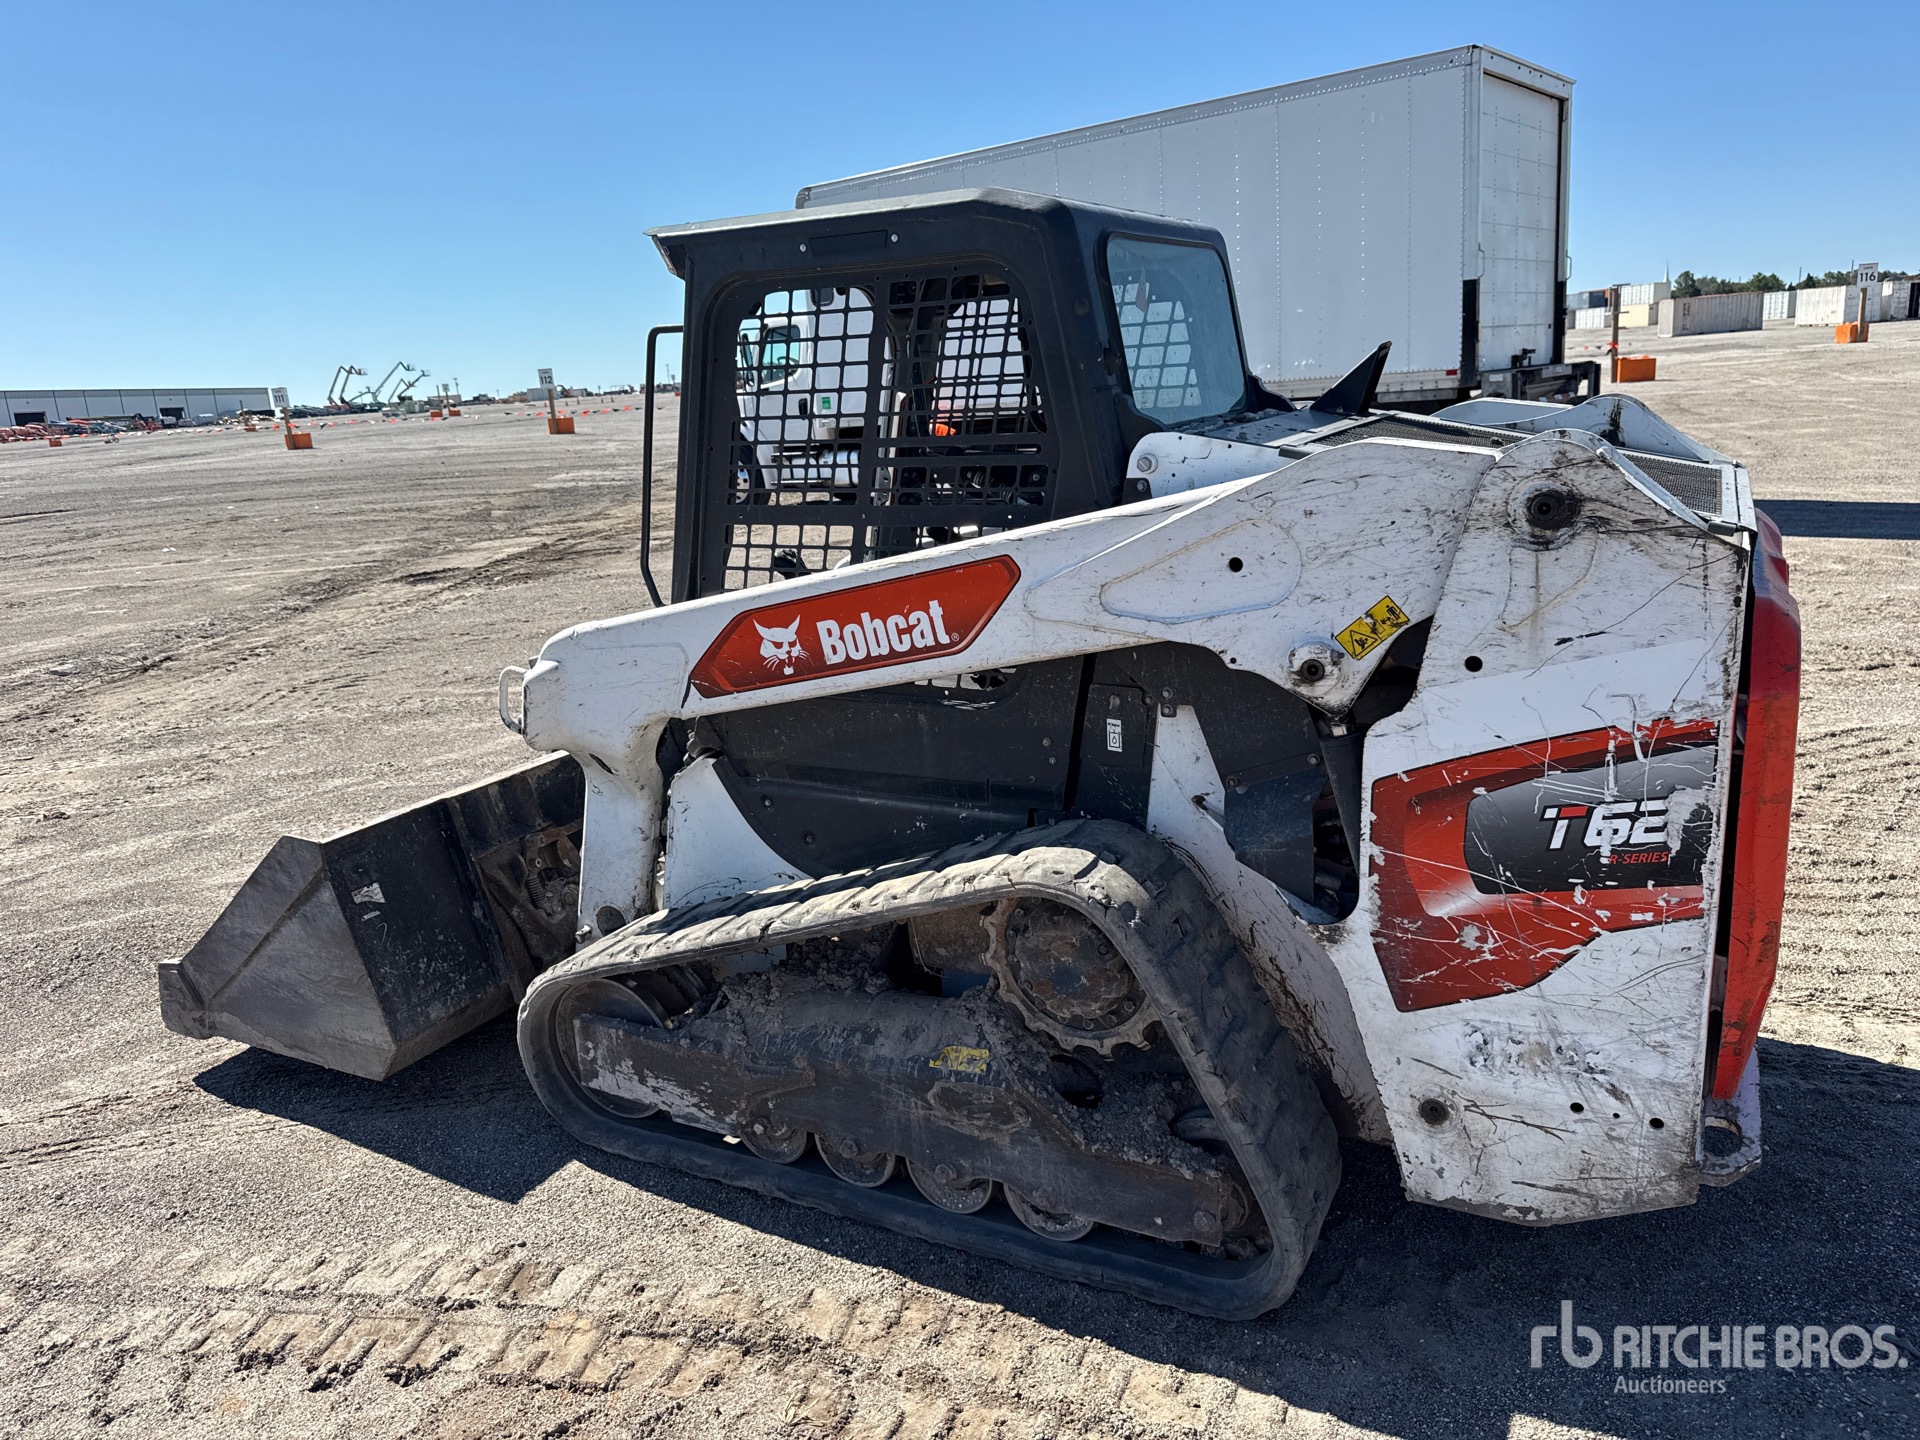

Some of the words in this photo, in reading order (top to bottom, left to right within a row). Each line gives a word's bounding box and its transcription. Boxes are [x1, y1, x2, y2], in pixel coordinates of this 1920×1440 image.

[1859, 271, 1876, 282] 116
[540, 375, 553, 384] 112
[274, 394, 285, 403] 111
[816, 600, 950, 665] Bobcat
[1608, 851, 1670, 865] R-SERIES
